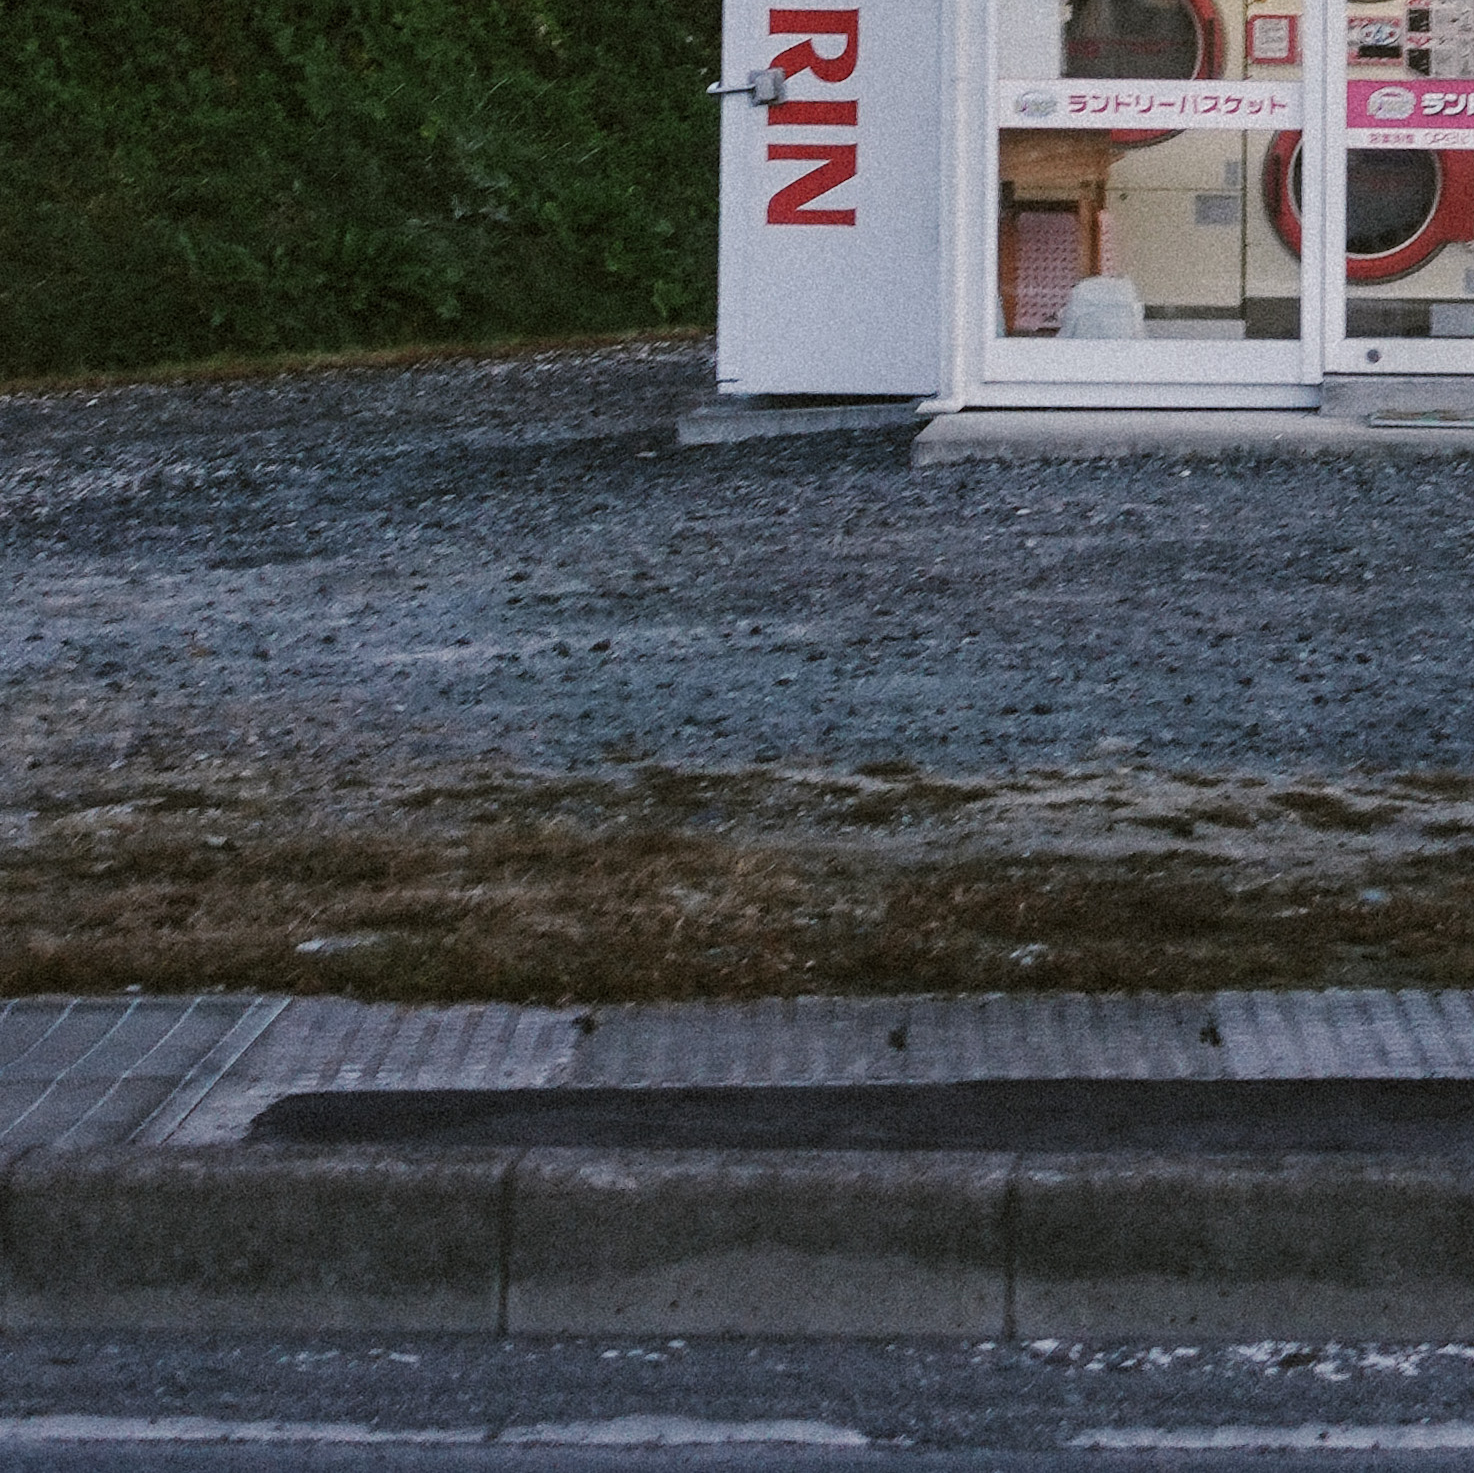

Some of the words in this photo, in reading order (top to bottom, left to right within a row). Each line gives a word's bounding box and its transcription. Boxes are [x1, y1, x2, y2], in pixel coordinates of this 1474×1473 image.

[1067, 93, 1288, 115] ランドリーバスケット
